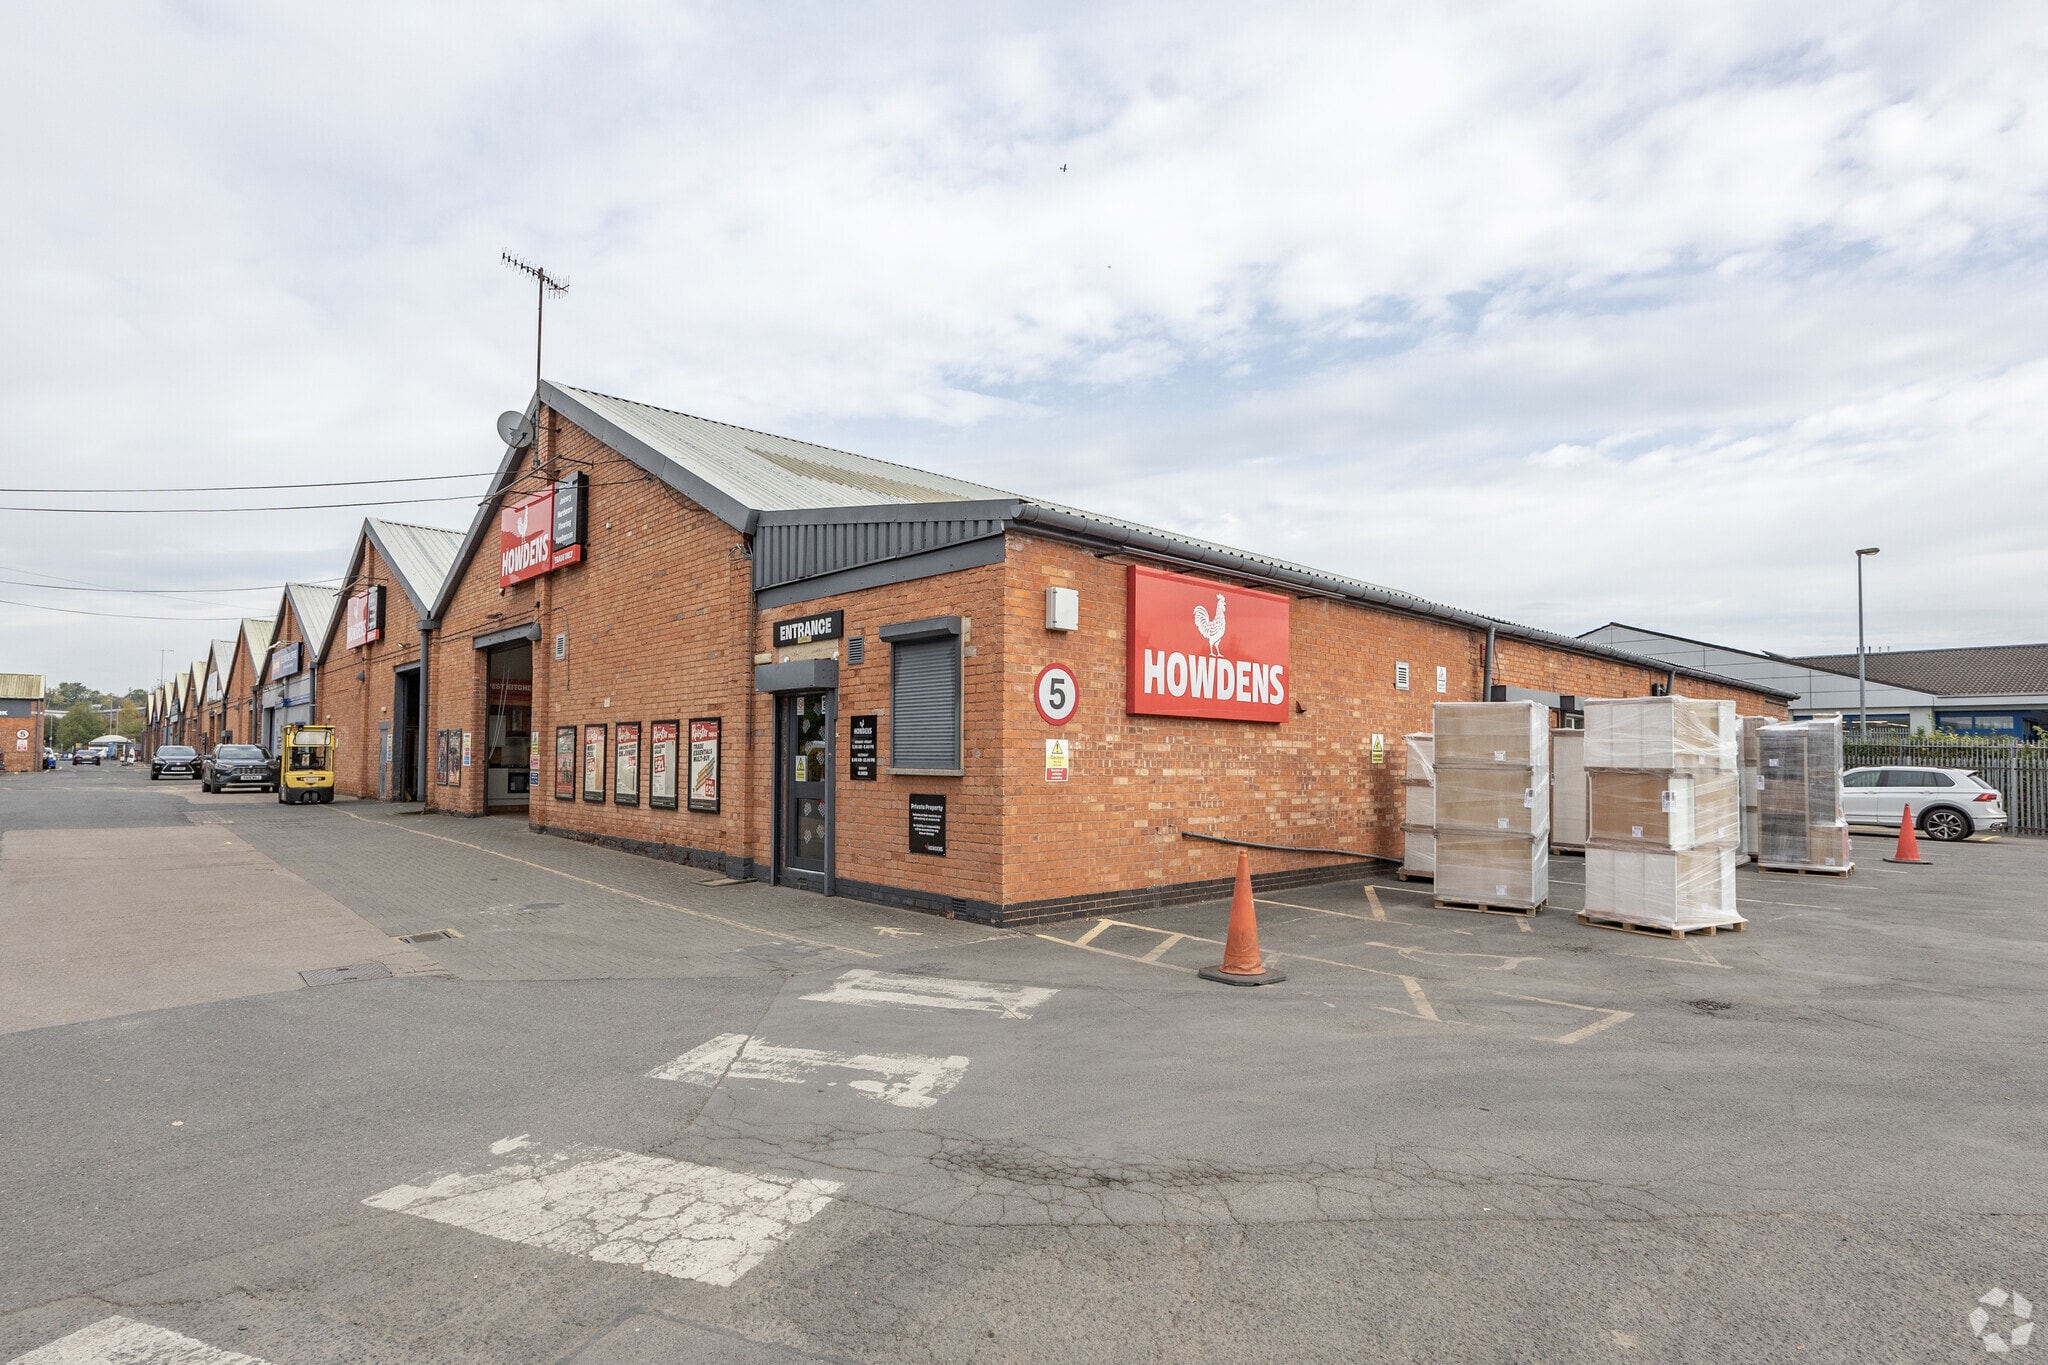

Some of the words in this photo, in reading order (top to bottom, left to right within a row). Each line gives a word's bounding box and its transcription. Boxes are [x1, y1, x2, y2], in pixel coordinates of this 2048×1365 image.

[501, 533, 549, 577] HOWDENS
[780, 617, 832, 641] ENTRANCE
[1049, 678, 1066, 710] 5
[1144, 648, 1285, 705] HOWDENS
